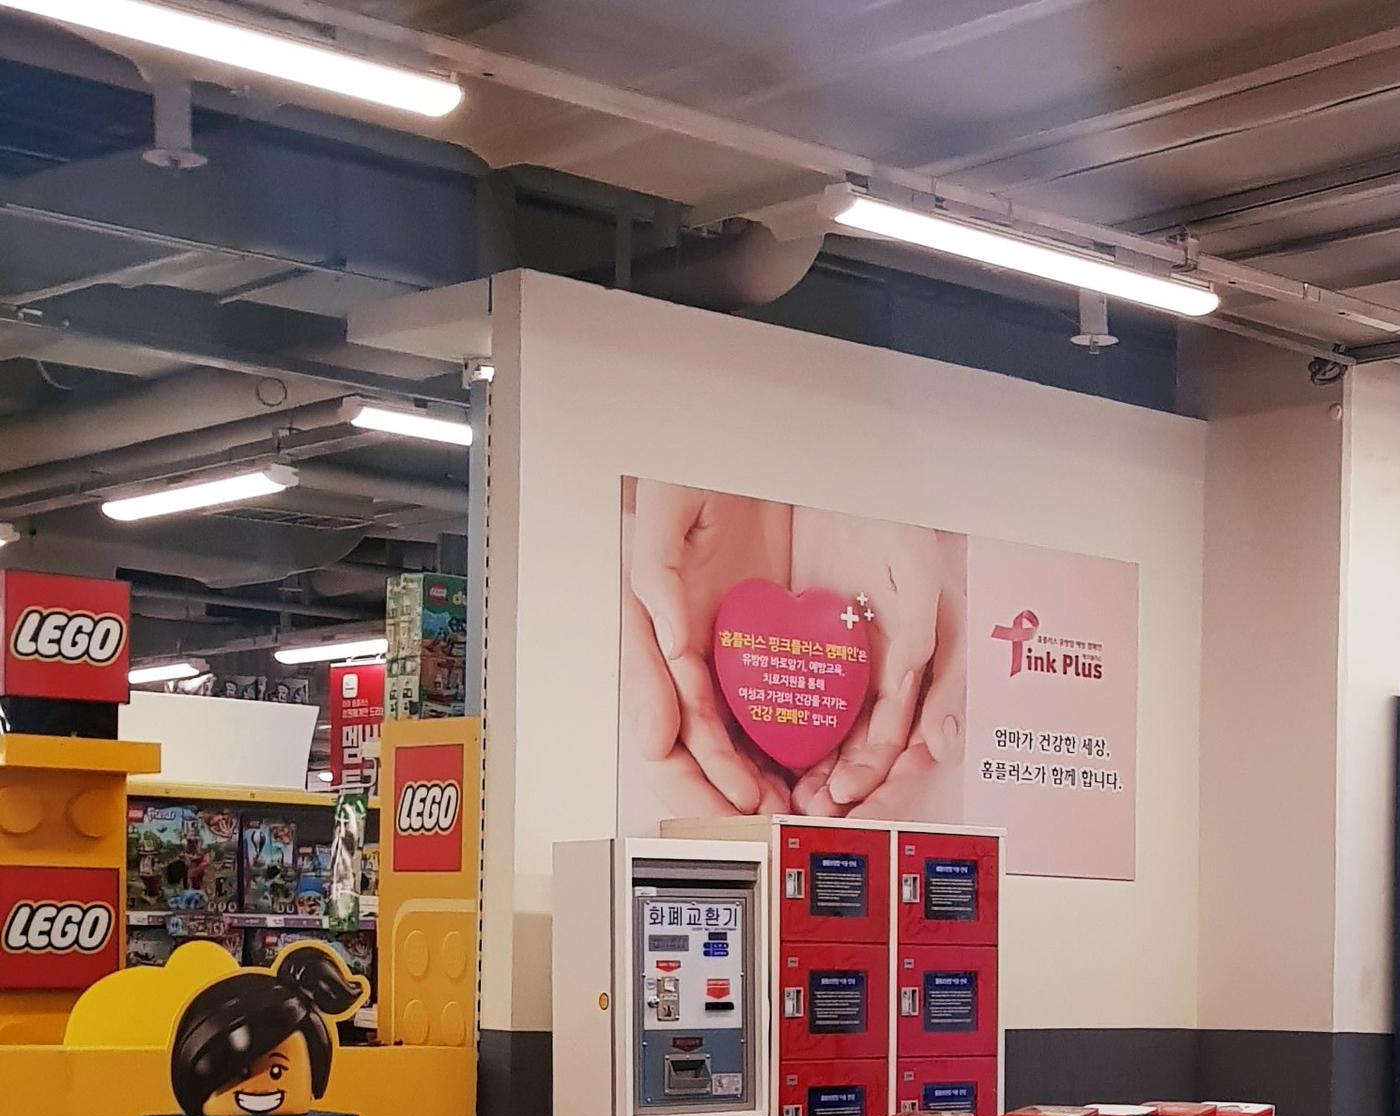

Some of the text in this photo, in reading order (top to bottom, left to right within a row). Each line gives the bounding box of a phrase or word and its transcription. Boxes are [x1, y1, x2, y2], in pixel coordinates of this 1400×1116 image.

[12, 609, 125, 664] LEGO
[768, 636, 824, 657] 핑크플러스
[742, 652, 769, 667] 유방암
[1062, 653, 1103, 680] Plus
[762, 672, 825, 691] 치료지원을 통해
[738, 687, 848, 711] 여성과 가정의 건강을 지키는
[812, 713, 838, 728] 입니다
[994, 728, 1111, 758] 엄마가 건강한 세상,
[981, 760, 1123, 791] 홈플러스가 함께 합니다.
[398, 783, 459, 834] LEGO
[5, 902, 112, 953] LEGO
[649, 906, 737, 927] 화폐교환기
